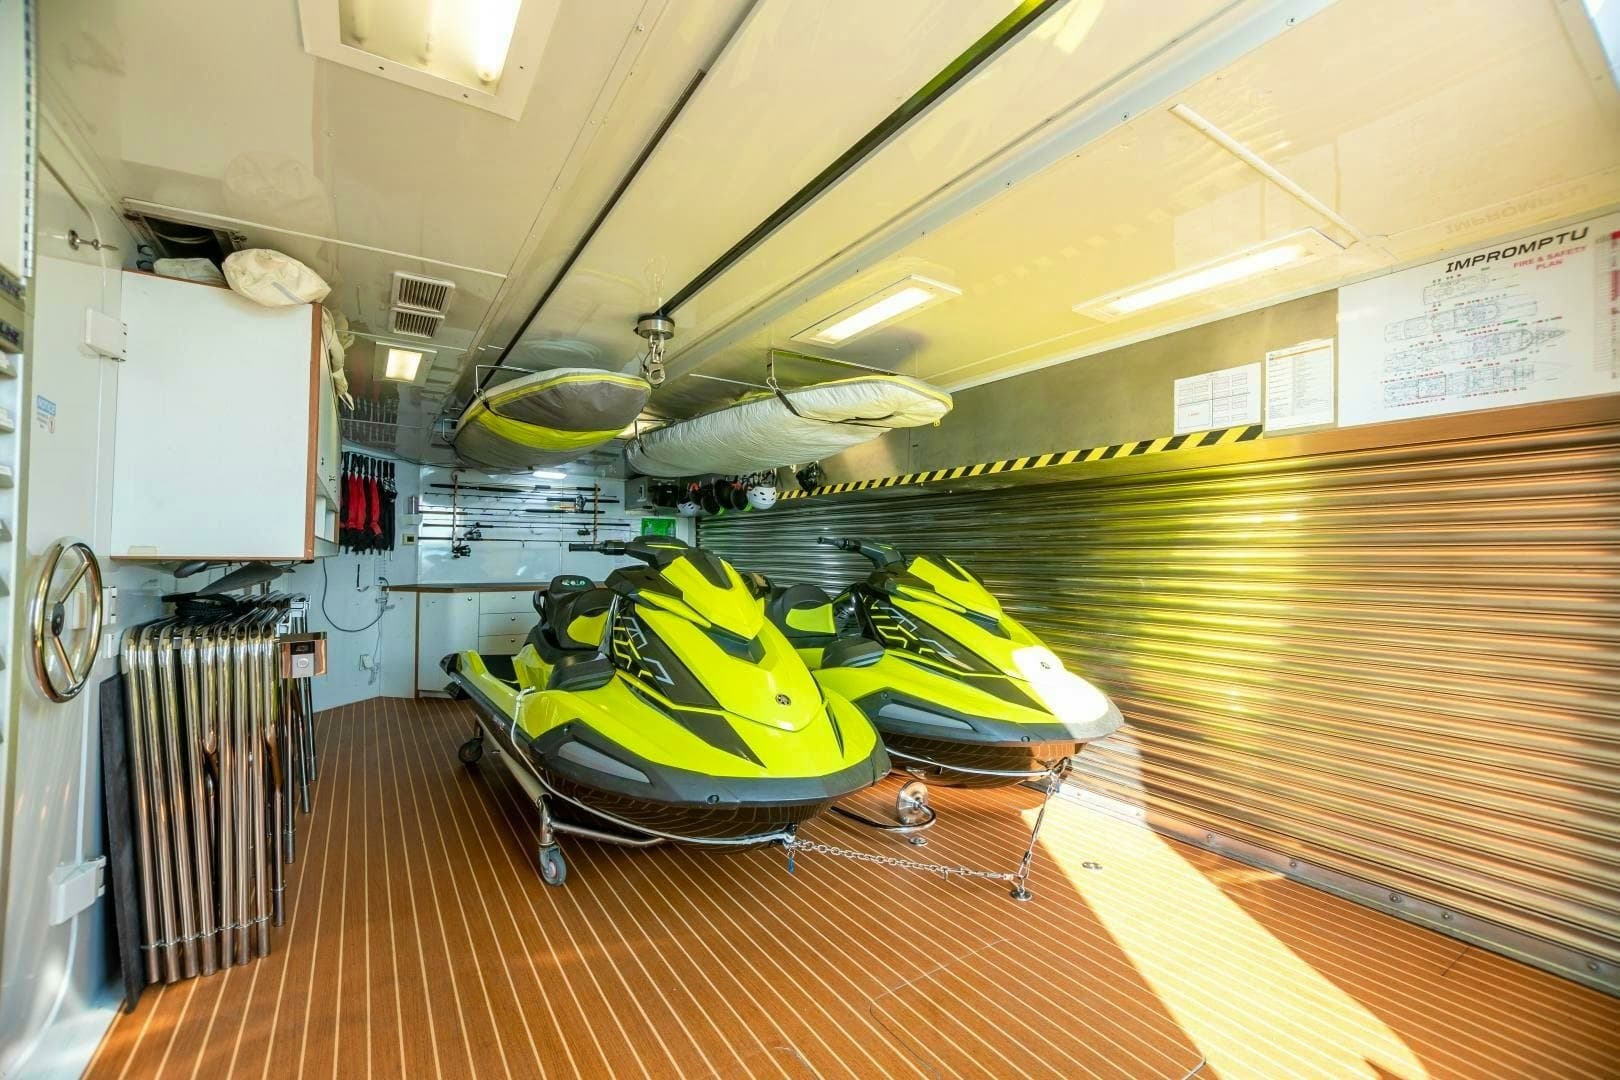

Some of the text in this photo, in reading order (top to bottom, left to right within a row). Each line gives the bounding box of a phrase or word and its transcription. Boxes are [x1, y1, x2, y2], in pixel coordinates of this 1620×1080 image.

[1446, 227, 1589, 273] IMPROMPTU
[1513, 256, 1533, 268] FIRE
[1547, 245, 1588, 260] SAFETY
[1536, 259, 1564, 270] PLAN
